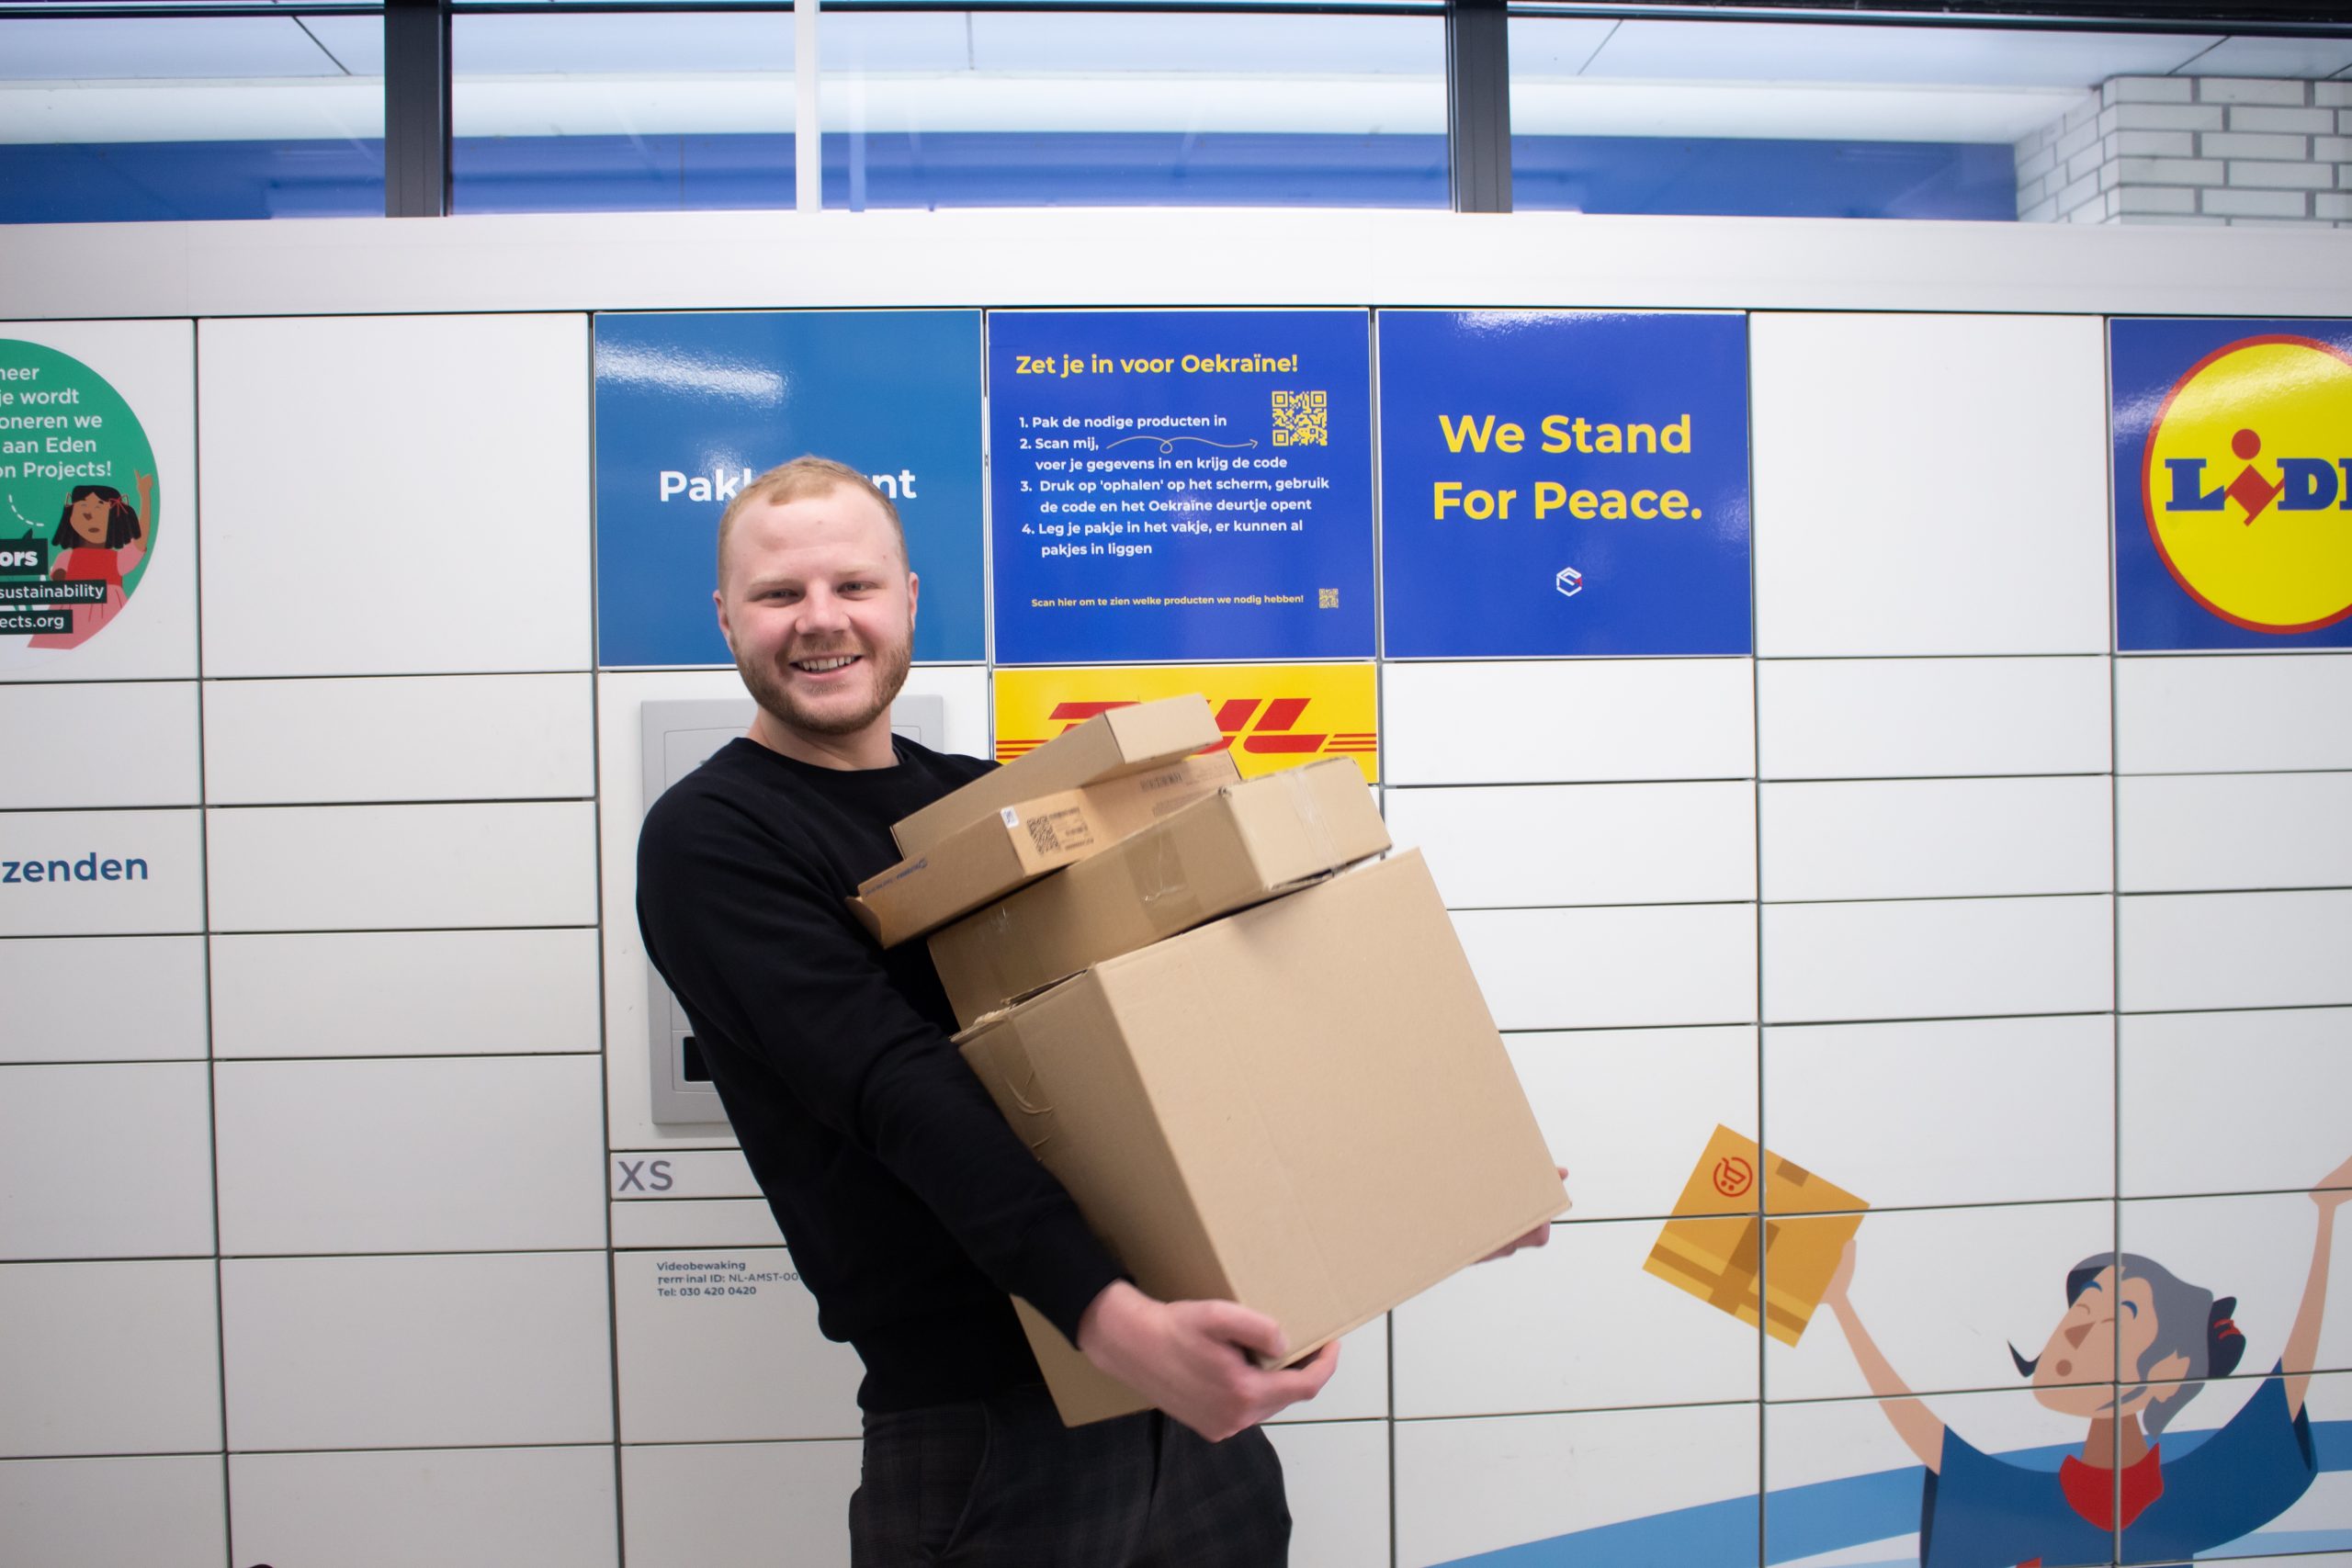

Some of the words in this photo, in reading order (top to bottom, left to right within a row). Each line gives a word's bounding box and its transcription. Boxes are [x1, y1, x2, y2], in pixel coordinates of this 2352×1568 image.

[1015, 355, 1057, 375] Zet
[1060, 353, 1085, 378] je
[1091, 353, 1114, 374] in
[1120, 357, 1175, 373] voor
[1181, 353, 1298, 373] Oekraïne!
[19, 388, 79, 405] wordt
[0, 415, 68, 430] oneren
[74, 415, 103, 428] we
[1019, 416, 1029, 428] 1.
[1032, 416, 1059, 428] Pak
[1062, 415, 1080, 428] de
[1084, 415, 1134, 430] nodige
[1136, 415, 1210, 429] producten
[1214, 413, 1227, 426] in
[1438, 414, 1525, 454] We
[1541, 413, 1691, 454] Stand
[2, 441, 39, 454] aan
[46, 436, 96, 453] Eden
[1019, 437, 1032, 450] 2.
[1035, 437, 1069, 450] Scan
[1073, 436, 1099, 451] mij,
[23, 461, 111, 480] Projects!
[1035, 461, 1067, 471] voer
[1069, 457, 1083, 472] je
[1086, 459, 1155, 472] gegevens
[1158, 457, 1171, 469] in
[1175, 459, 1193, 469] en
[1196, 457, 1228, 472] krijg
[1231, 457, 1250, 468] de
[1253, 456, 1288, 468] code
[1020, 480, 1033, 492] 3.
[1040, 479, 1075, 492] Druk
[1078, 481, 1097, 494] op
[1100, 479, 1164, 493] 'ophalen'
[1167, 480, 1186, 493] op
[1189, 479, 1213, 491] het
[1216, 478, 1272, 491] scherm,
[1274, 476, 1329, 492] gebruik
[1040, 501, 1058, 513] de
[1061, 501, 1096, 513] code
[1100, 502, 1118, 513] en
[1121, 500, 1146, 513] het
[1148, 499, 1213, 513] Oekraïne
[1216, 498, 1268, 513] deurtje
[1271, 499, 1312, 513] opent
[1433, 481, 1517, 520] For
[1534, 481, 1702, 520] Peace.
[1022, 524, 1035, 535] 4.
[1038, 524, 1065, 536] Leg
[1067, 521, 1081, 536] je
[1084, 521, 1124, 536] pakje
[1126, 521, 1140, 534] in
[1144, 521, 1168, 533] het
[1170, 520, 1213, 536] vakje,
[1216, 522, 1230, 532] er
[1233, 520, 1287, 532] kunnen
[1290, 519, 1303, 531] al
[1041, 543, 1088, 558] pakjes
[1091, 542, 1104, 555] in
[1108, 542, 1152, 558] liggen
[0, 551, 39, 567] ors
[0, 583, 105, 601] sustainability
[1031, 599, 1056, 608] Scan
[1057, 598, 1077, 607] hier
[1079, 599, 1095, 607] om
[1097, 598, 1108, 606] te
[1110, 597, 1130, 606] zien
[1132, 596, 1162, 605] welke
[1163, 595, 1215, 607] producten
[1216, 596, 1232, 605] we
[1233, 594, 1262, 606] nodig
[1263, 594, 1305, 604] hebben!
[0, 615, 64, 629] ects.org
[2, 852, 148, 884] zenden
[617, 1159, 673, 1192] XS
[656, 1261, 746, 1272] Videobewaking
[709, 1274, 726, 1283] ID:
[657, 1288, 676, 1297] Tel:
[679, 1288, 701, 1297] 030
[704, 1287, 725, 1296] 420
[728, 1286, 757, 1296] 0420
